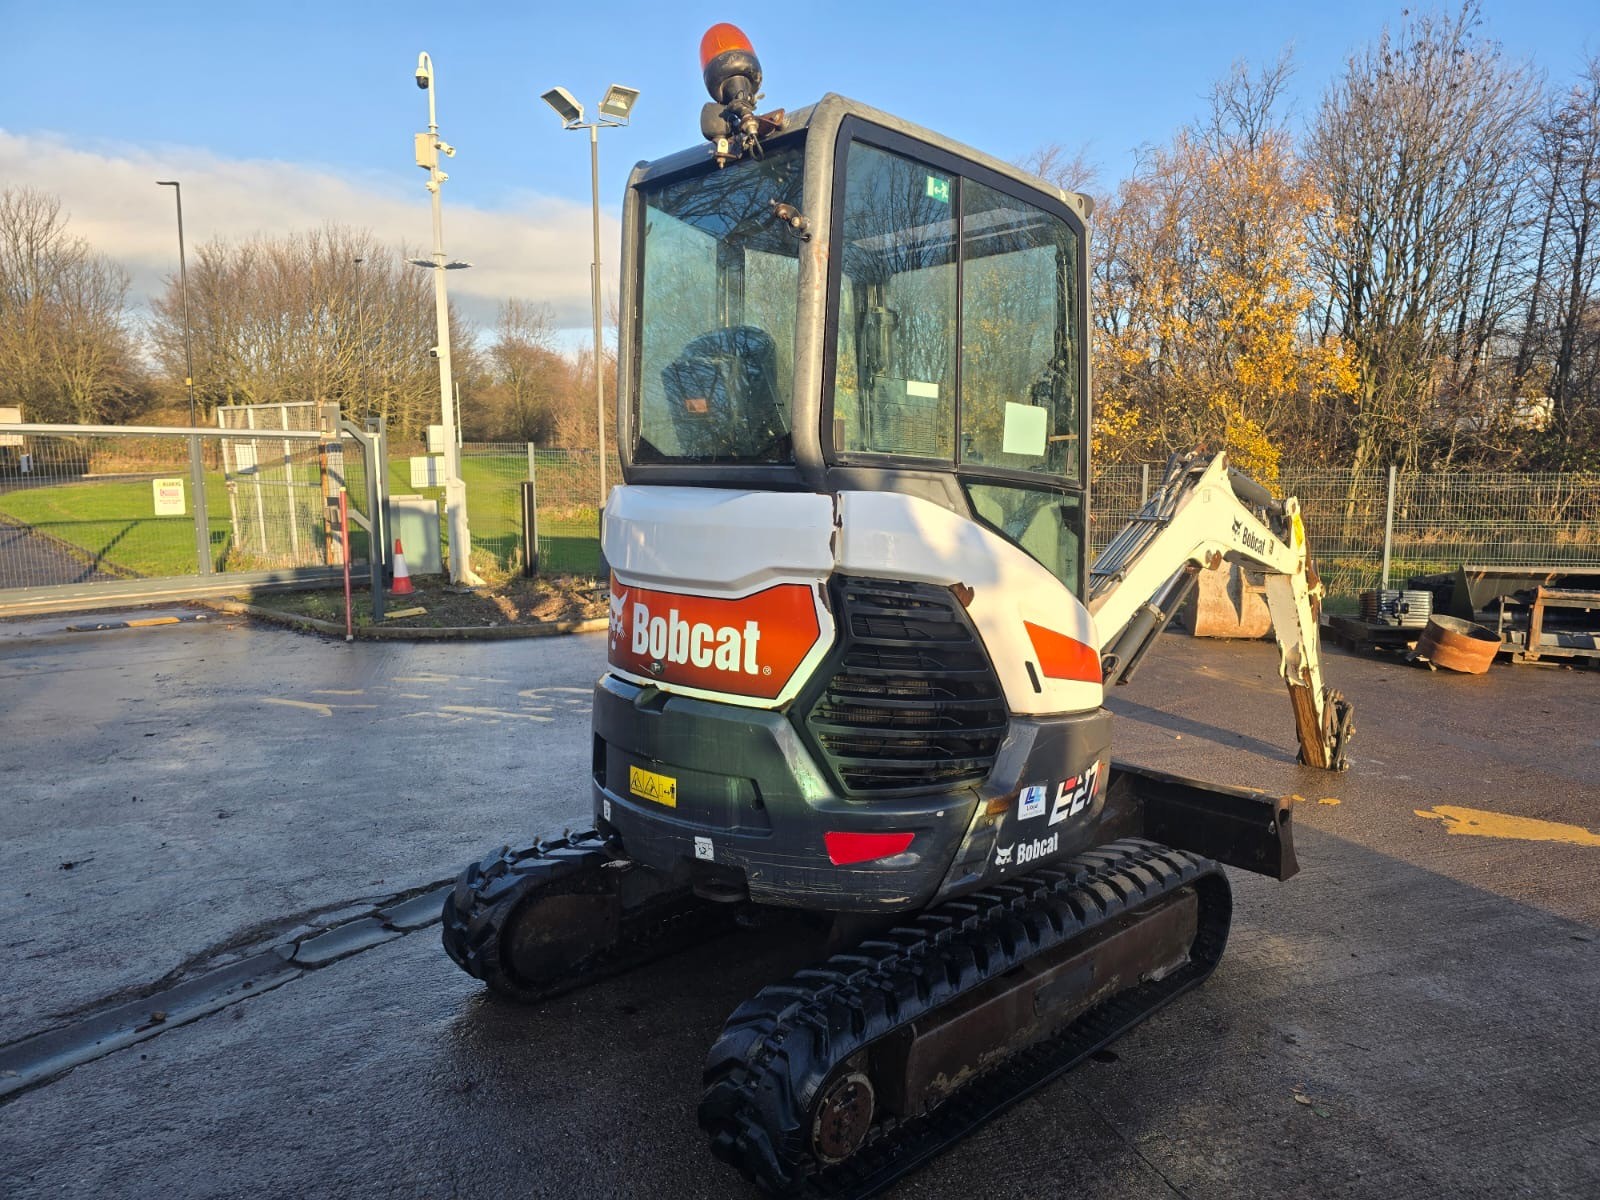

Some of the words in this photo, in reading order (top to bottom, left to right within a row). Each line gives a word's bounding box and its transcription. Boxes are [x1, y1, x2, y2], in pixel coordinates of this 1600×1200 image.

[1242, 526, 1265, 556] Bobcat
[632, 602, 760, 675] Bobcat
[1016, 832, 1059, 866] Bobcat
